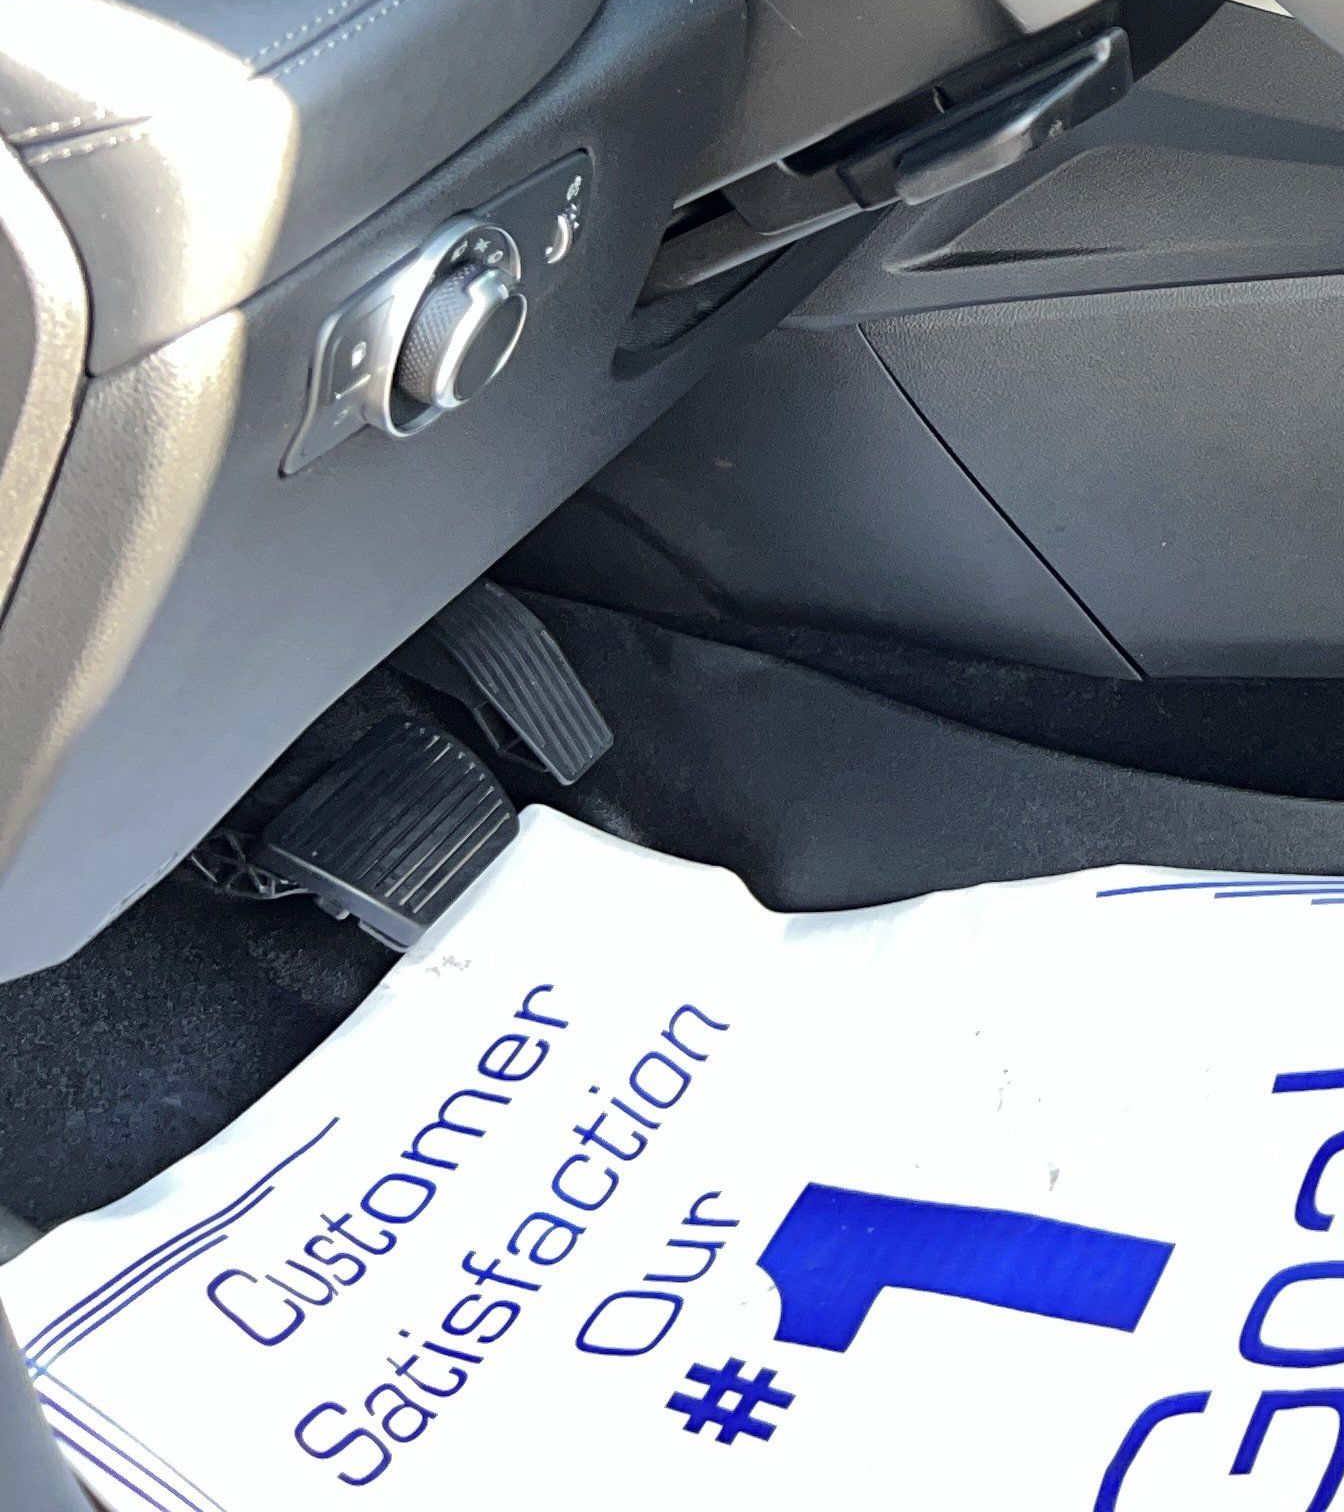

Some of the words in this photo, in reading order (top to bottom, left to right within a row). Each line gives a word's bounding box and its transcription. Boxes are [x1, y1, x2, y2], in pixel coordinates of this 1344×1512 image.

[207, 984, 569, 1347] Customer
[295, 1003, 731, 1487] Satisfaction
[575, 1190, 742, 1356] Our
